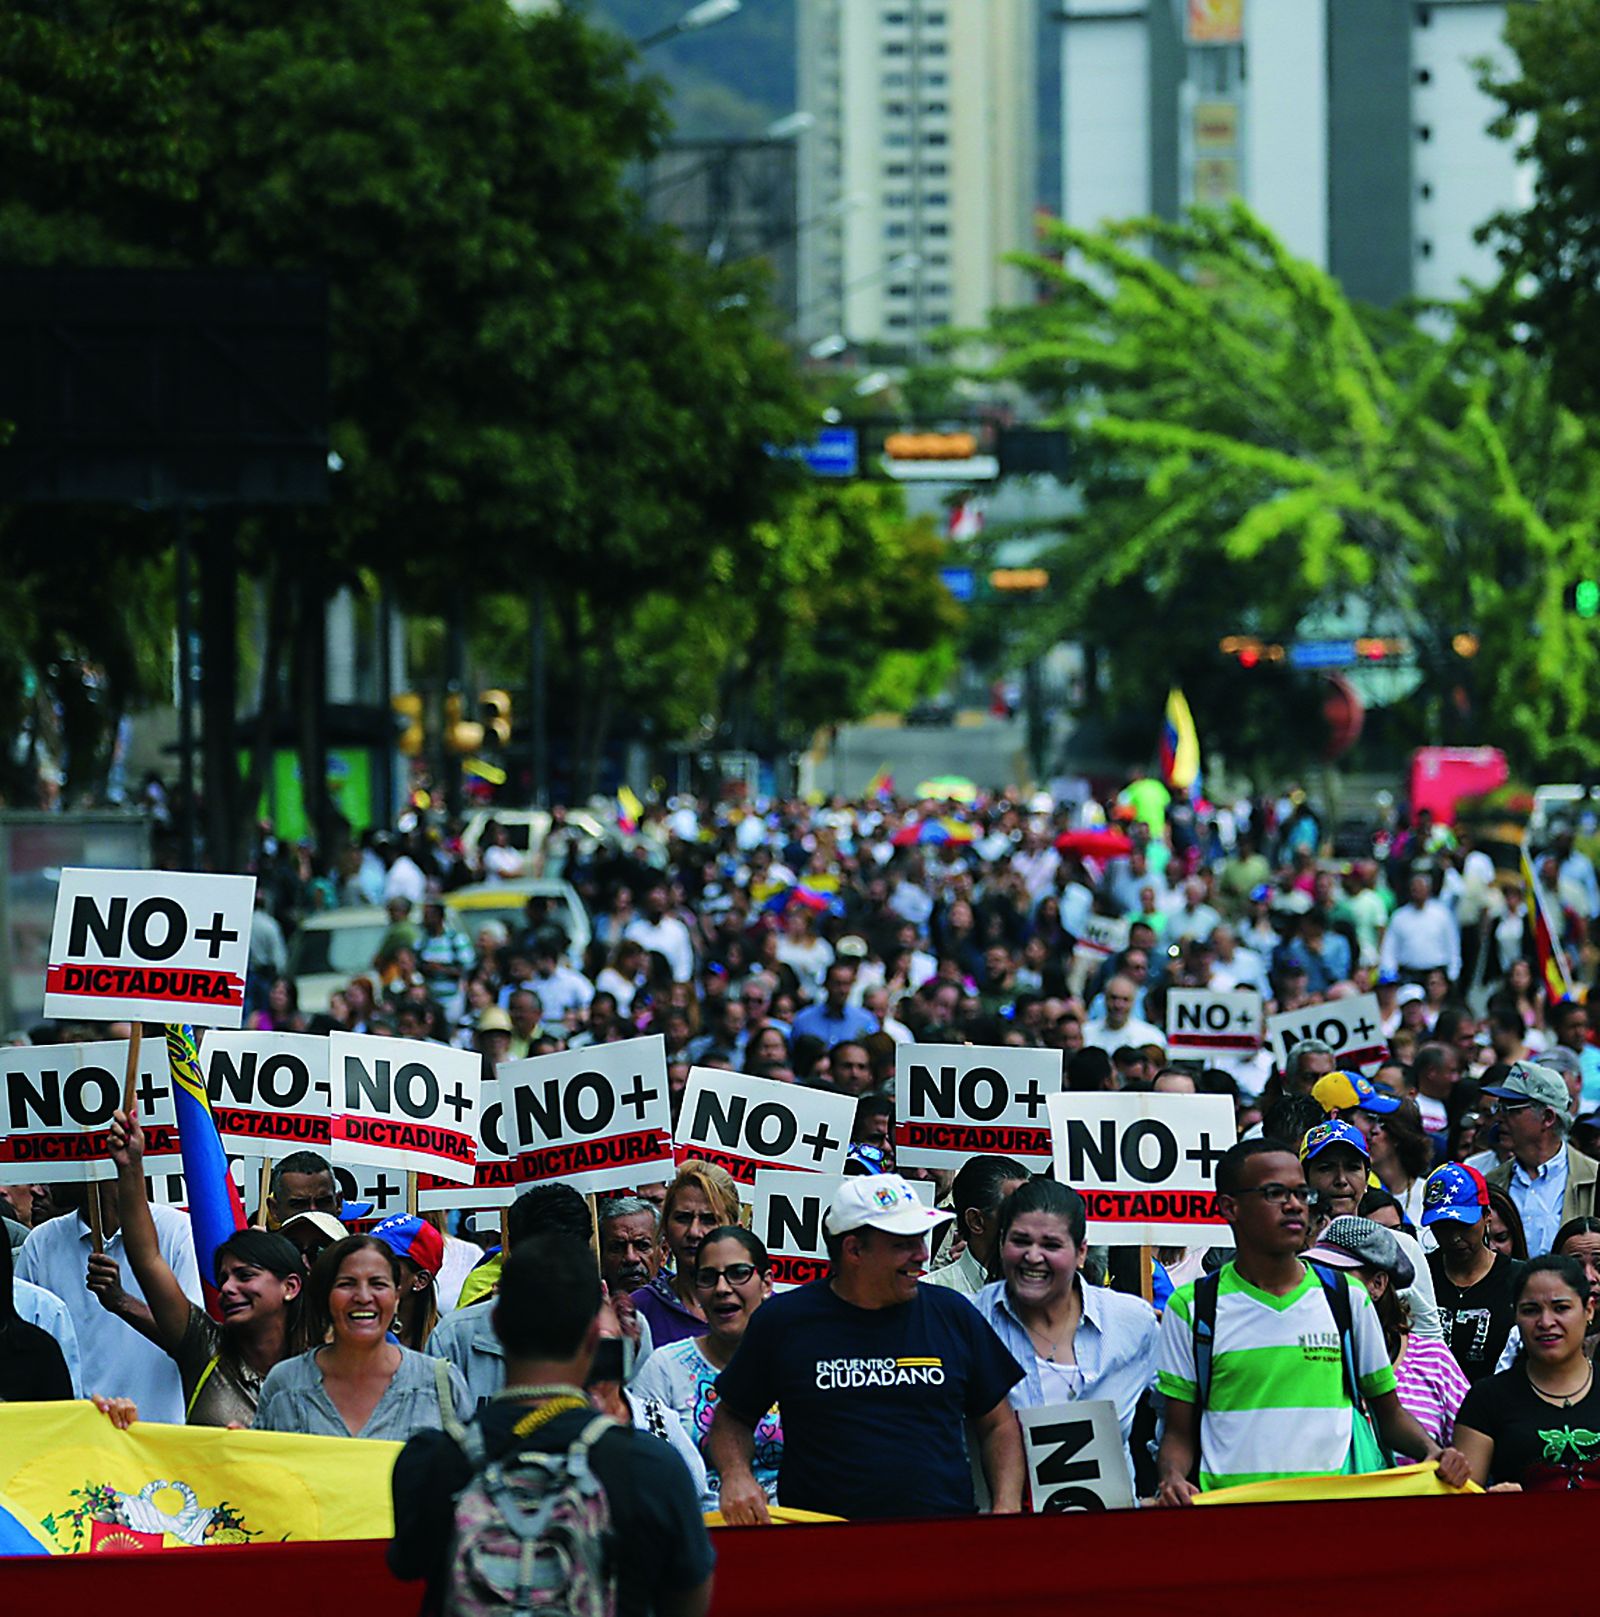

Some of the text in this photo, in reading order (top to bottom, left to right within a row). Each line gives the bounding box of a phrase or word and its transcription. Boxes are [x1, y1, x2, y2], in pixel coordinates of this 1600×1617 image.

[67, 896, 239, 961] NO+
[63, 968, 232, 999] DICTADURA
[1178, 1004, 1253, 1030] NO+
[6, 1066, 170, 1129] NO+
[344, 1056, 473, 1122] NO+
[514, 1072, 658, 1146] NO+
[909, 1066, 1047, 1121] NO+
[346, 1119, 469, 1158] DICTADURA
[690, 1090, 839, 1161] NO+
[910, 1127, 1051, 1151] DICTADURA
[523, 1134, 662, 1178] DICTADURA
[1067, 1119, 1226, 1183] NO+
[816, 1357, 896, 1373] ENCUENTRO
[816, 1367, 945, 1389] CIUDADANO
